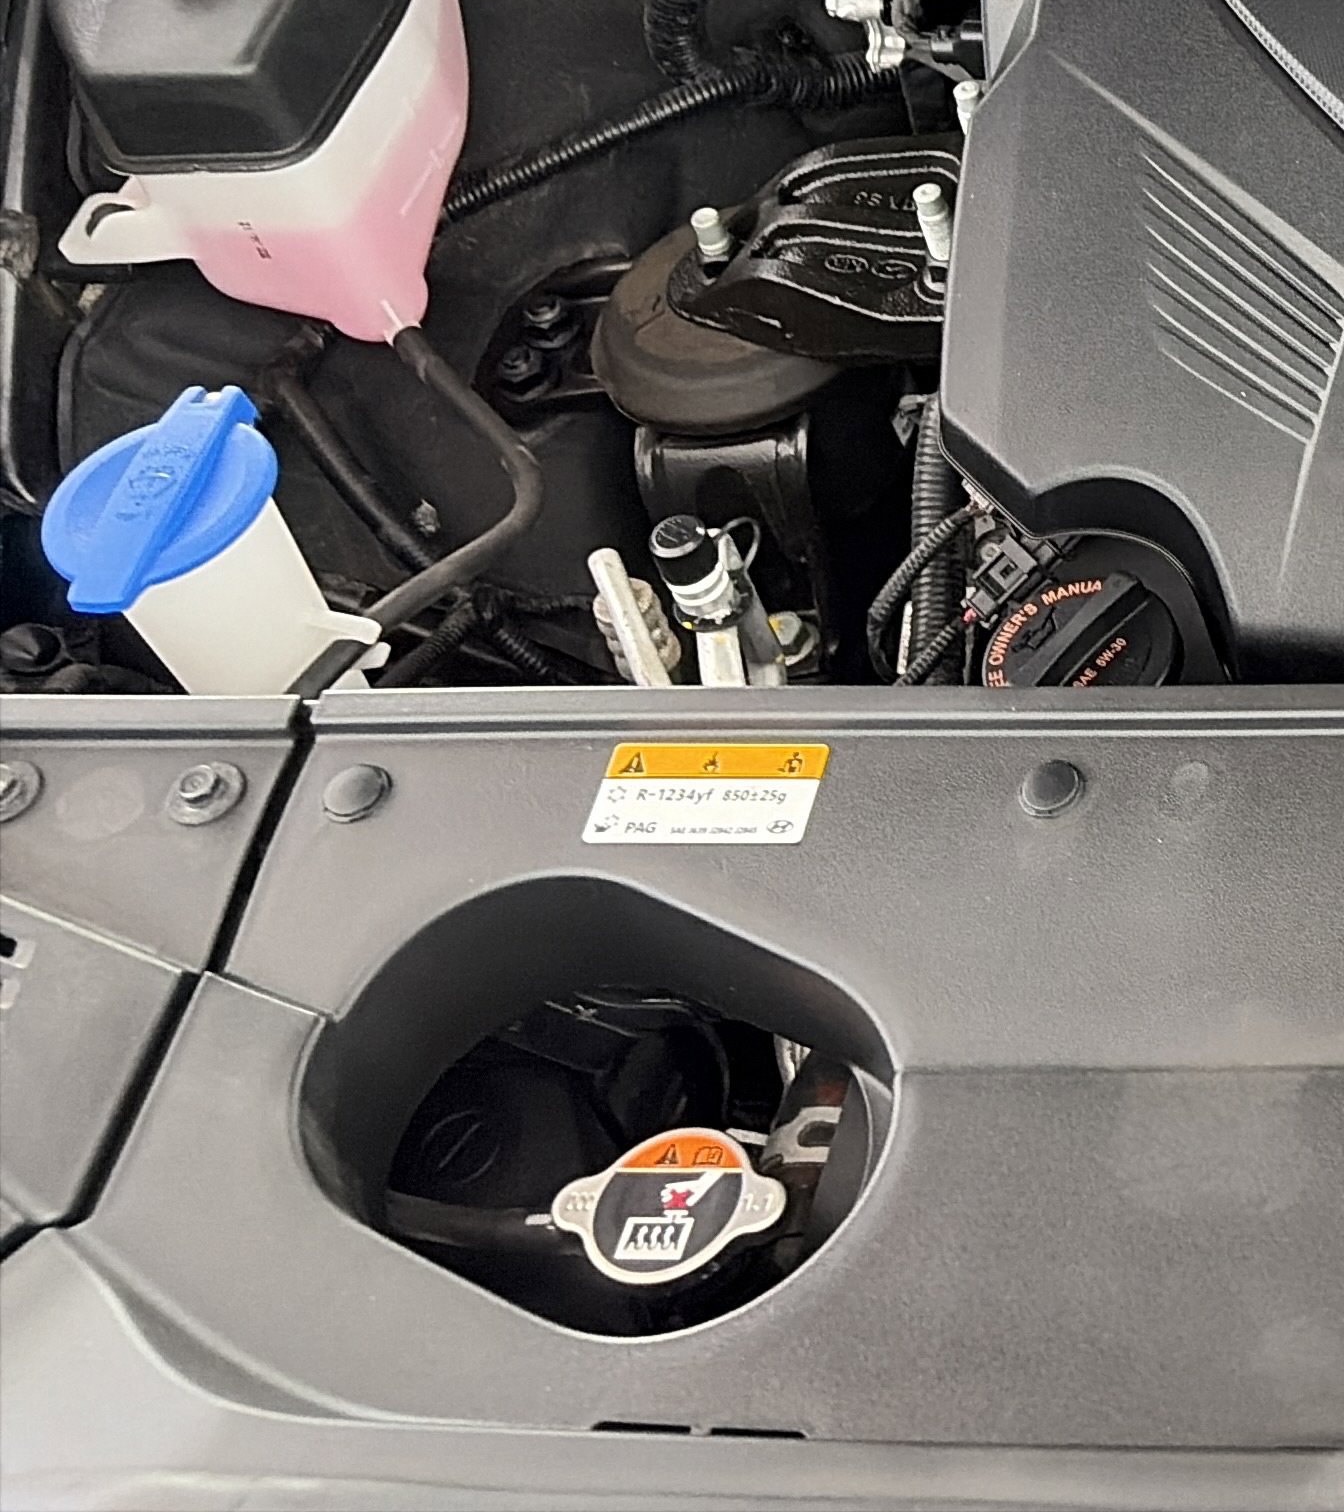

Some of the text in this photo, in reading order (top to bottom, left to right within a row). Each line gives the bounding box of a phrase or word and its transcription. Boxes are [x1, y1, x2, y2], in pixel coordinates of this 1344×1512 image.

[988, 602, 1039, 666] OWNER'S
[1041, 579, 1103, 606] MANUA
[636, 788, 715, 805] R-1234yf
[624, 821, 658, 834] PAG
